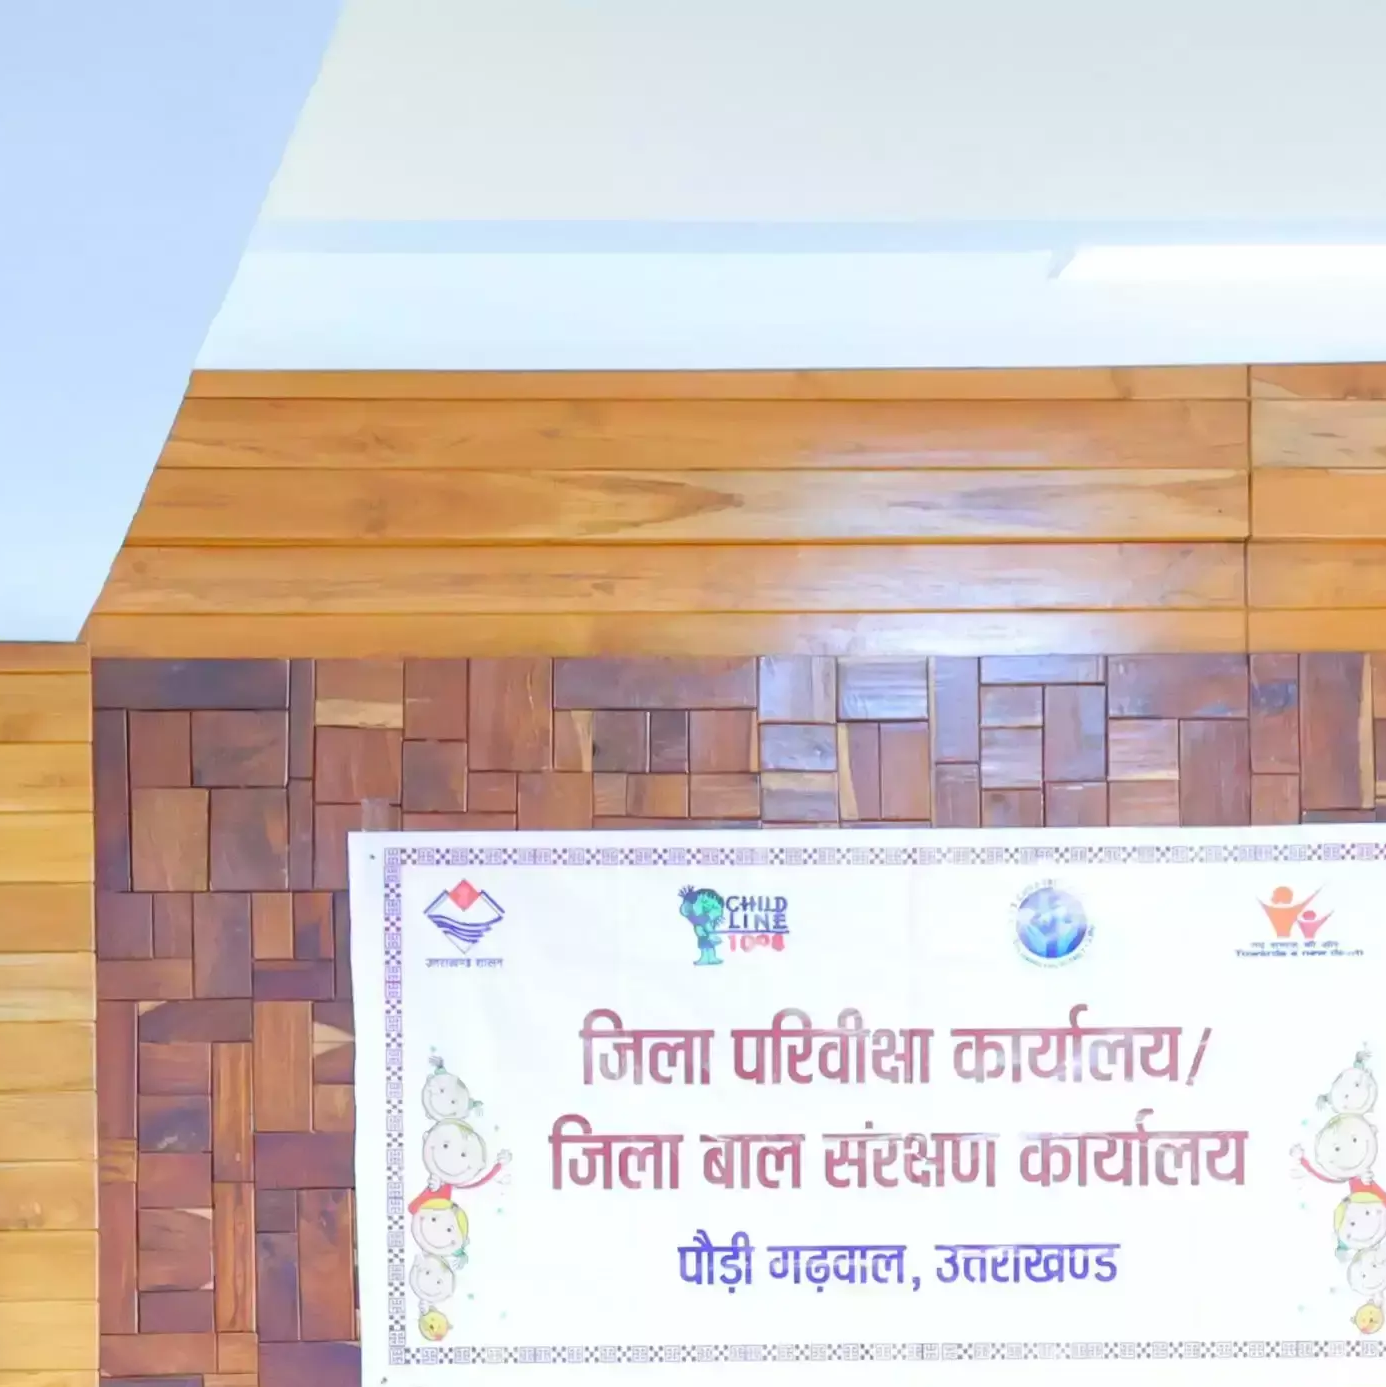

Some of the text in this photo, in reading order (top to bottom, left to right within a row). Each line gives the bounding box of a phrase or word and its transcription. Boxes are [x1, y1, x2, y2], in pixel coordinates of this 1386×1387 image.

[726, 895, 788, 913] CHILD
[728, 913, 788, 930] LINE
[579, 1004, 1212, 1087] जिला परिवीक्षा कार्यालय/
[548, 1108, 1249, 1191] जिला बाल संरक्षण कार्यालय
[677, 1229, 1121, 1293] पौड़ी गढ़वाल, उत्तराखण्ड
